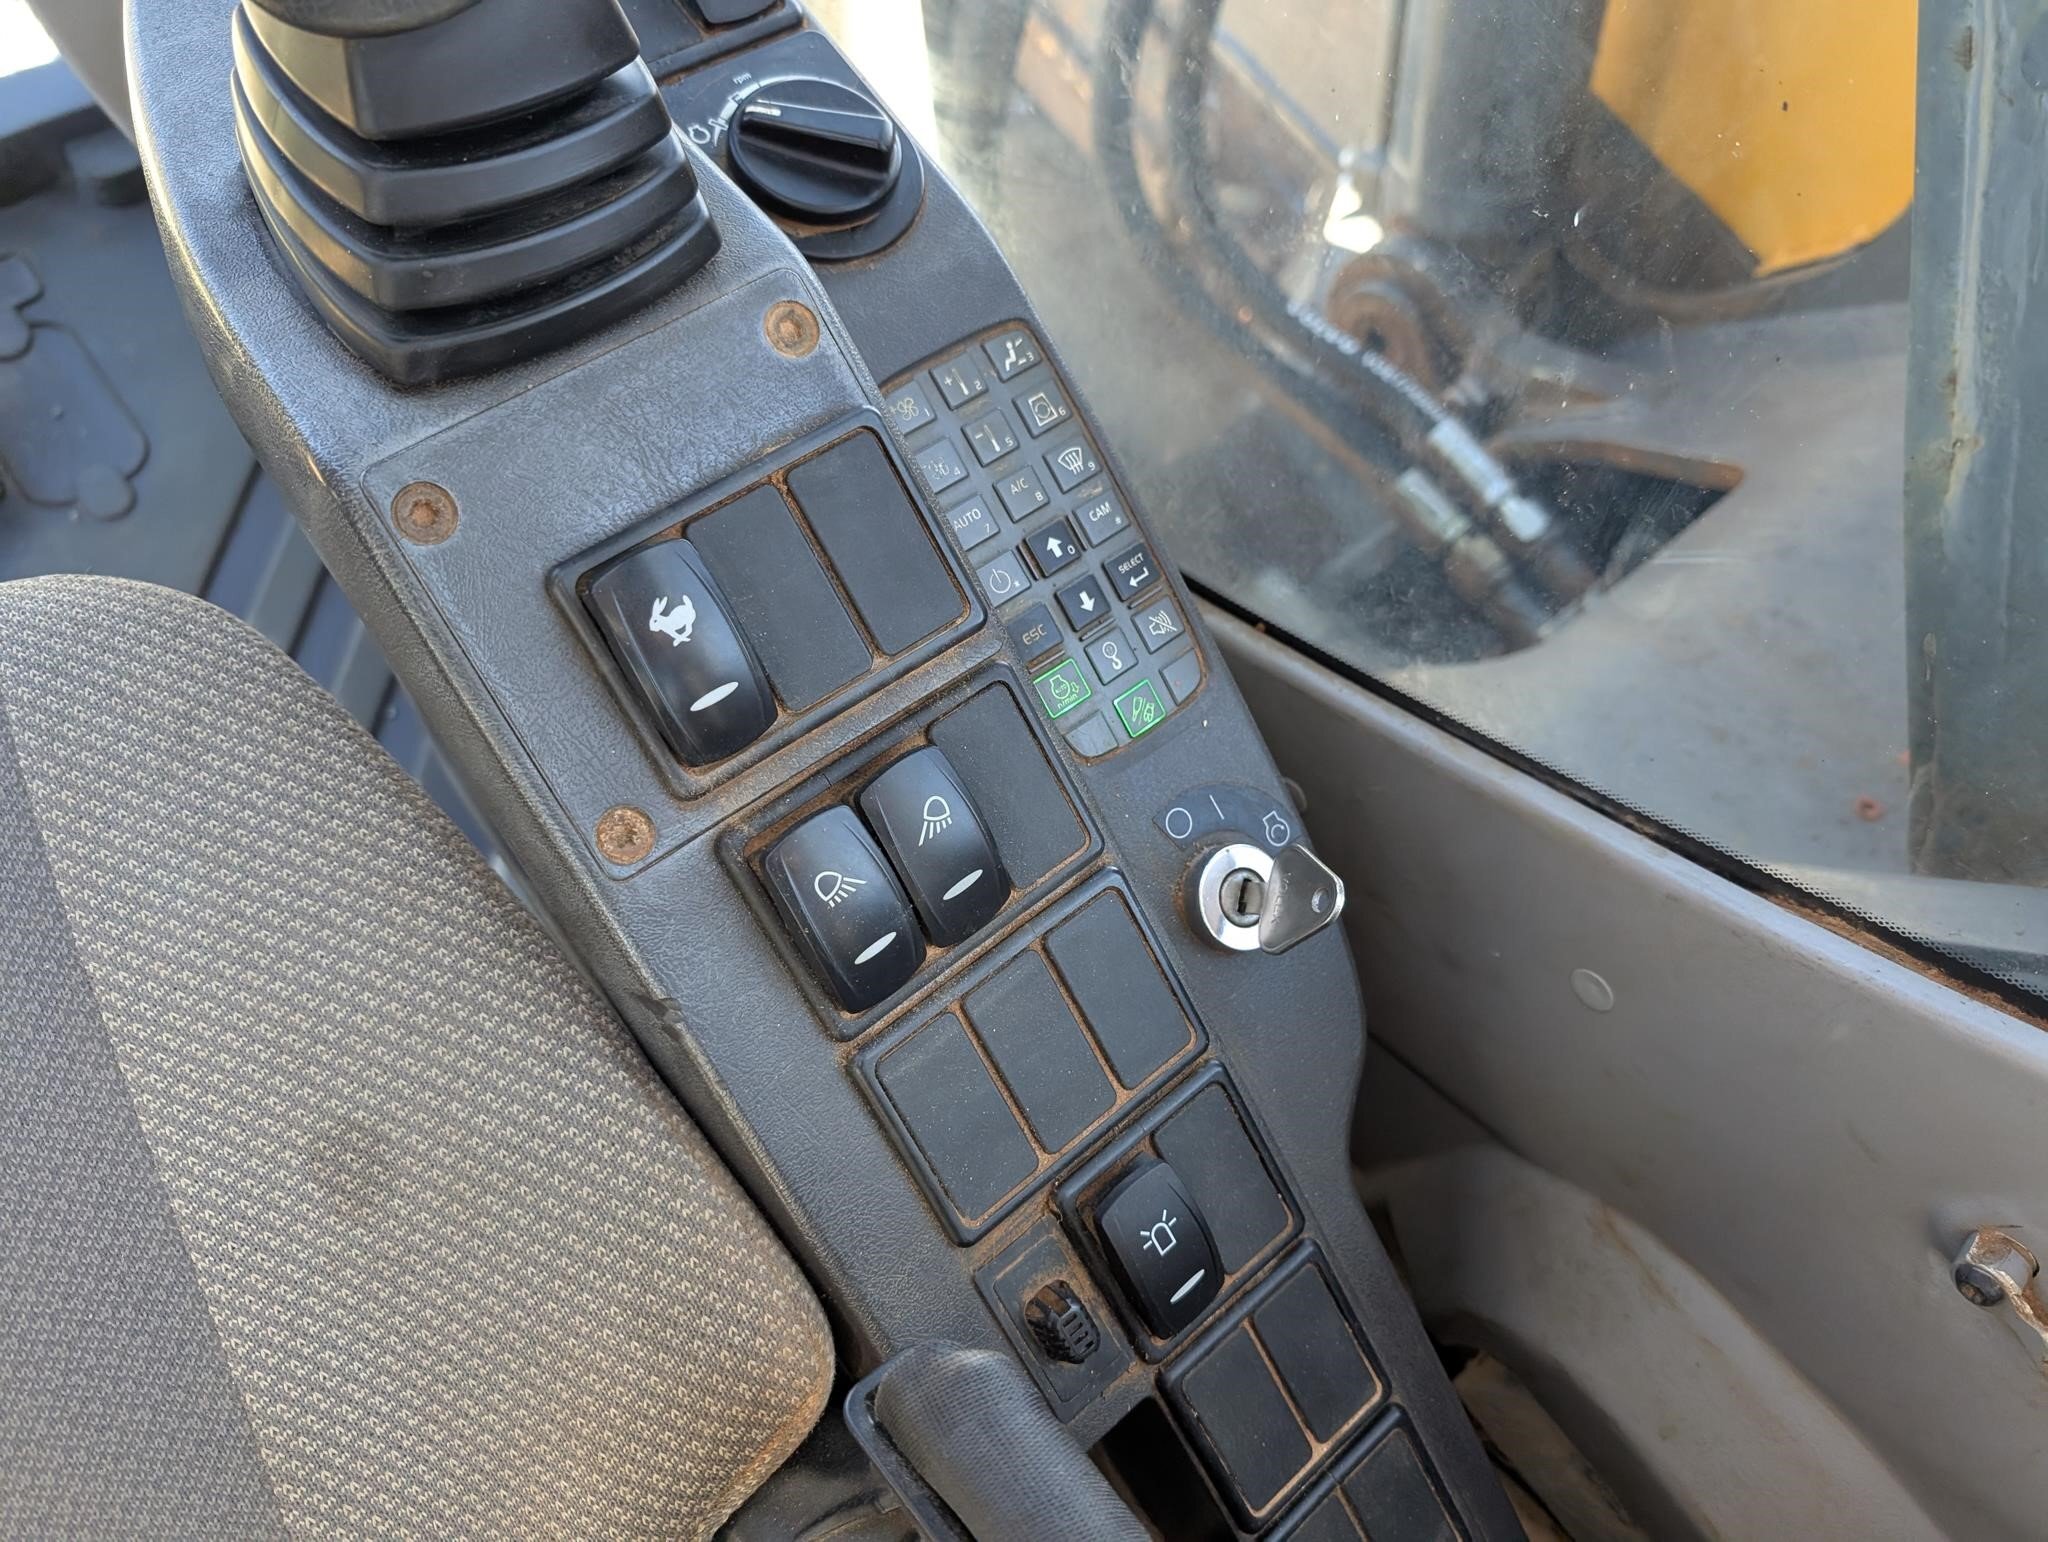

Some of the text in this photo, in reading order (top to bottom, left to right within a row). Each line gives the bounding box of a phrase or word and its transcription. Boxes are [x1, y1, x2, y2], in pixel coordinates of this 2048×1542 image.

[1026, 351, 1035, 362] 3
[973, 379, 983, 391] 2
[1058, 407, 1067, 416] 6
[1004, 436, 1014, 447] 5
[1087, 461, 1096, 471] 9
[1010, 477, 1029, 495] A/C
[1088, 501, 1112, 522] CAM
[953, 508, 982, 532] AUTO
[983, 523, 991, 534] 7
[1118, 552, 1144, 574] SELECT
[1022, 624, 1048, 645] ESC
